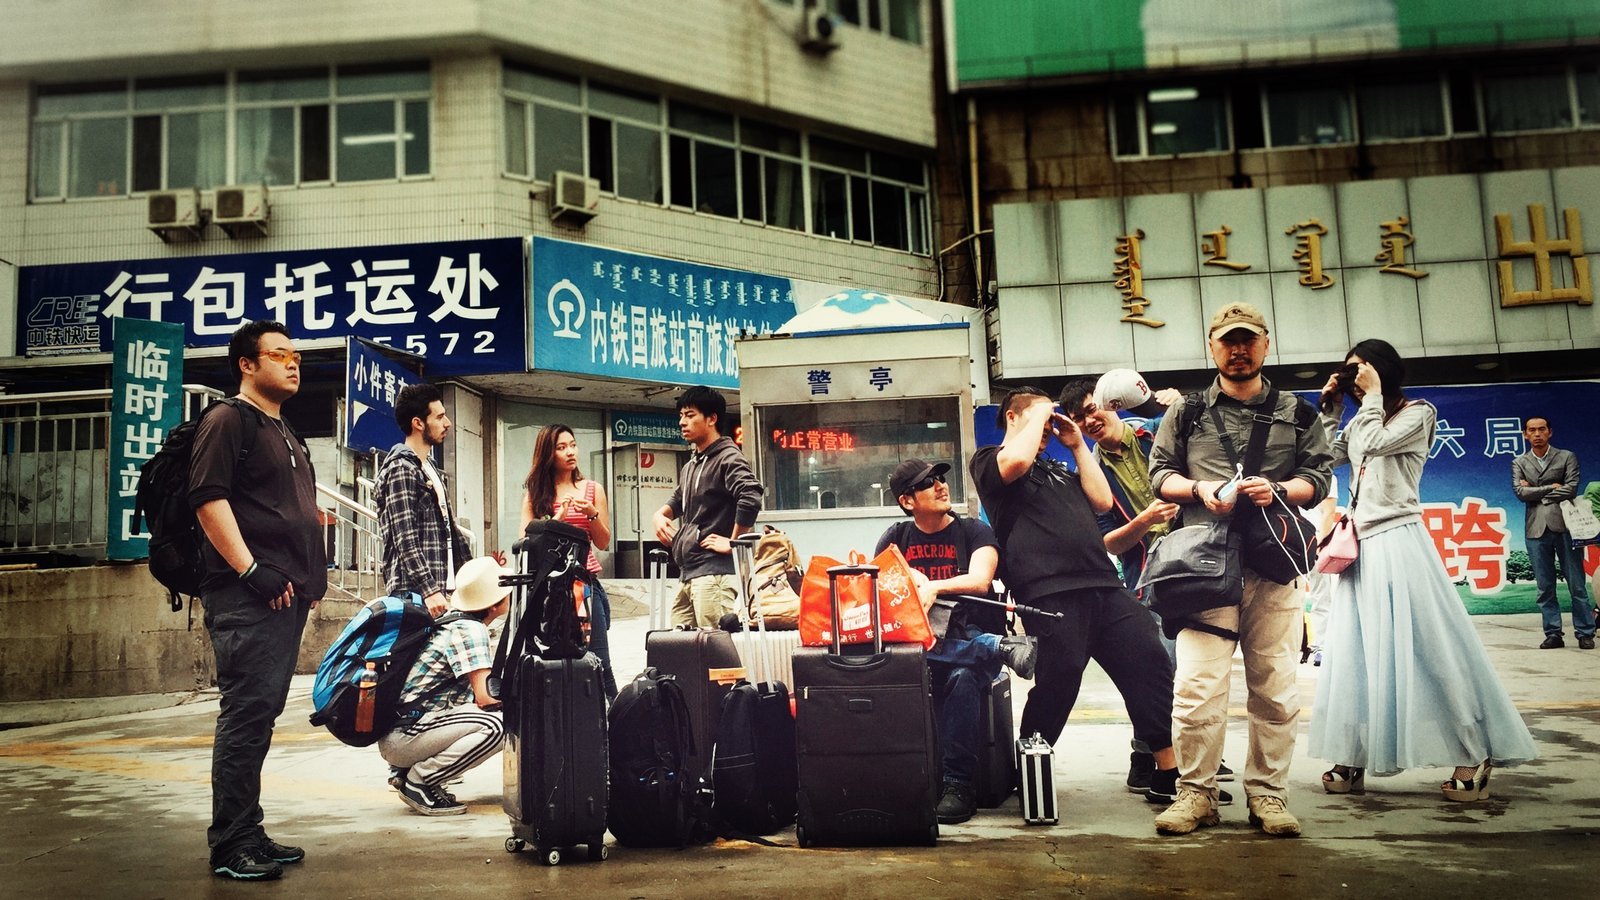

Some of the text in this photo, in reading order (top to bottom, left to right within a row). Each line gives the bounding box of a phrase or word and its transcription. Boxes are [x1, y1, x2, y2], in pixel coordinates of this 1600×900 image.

[1495, 203, 1592, 308] 出
[102, 252, 500, 337] 行包托运处
[27, 325, 100, 346] 中铁快运
[807, 367, 893, 395] 警亭
[1428, 417, 1527, 459] 六局
[1421, 501, 1507, 591] 跨
